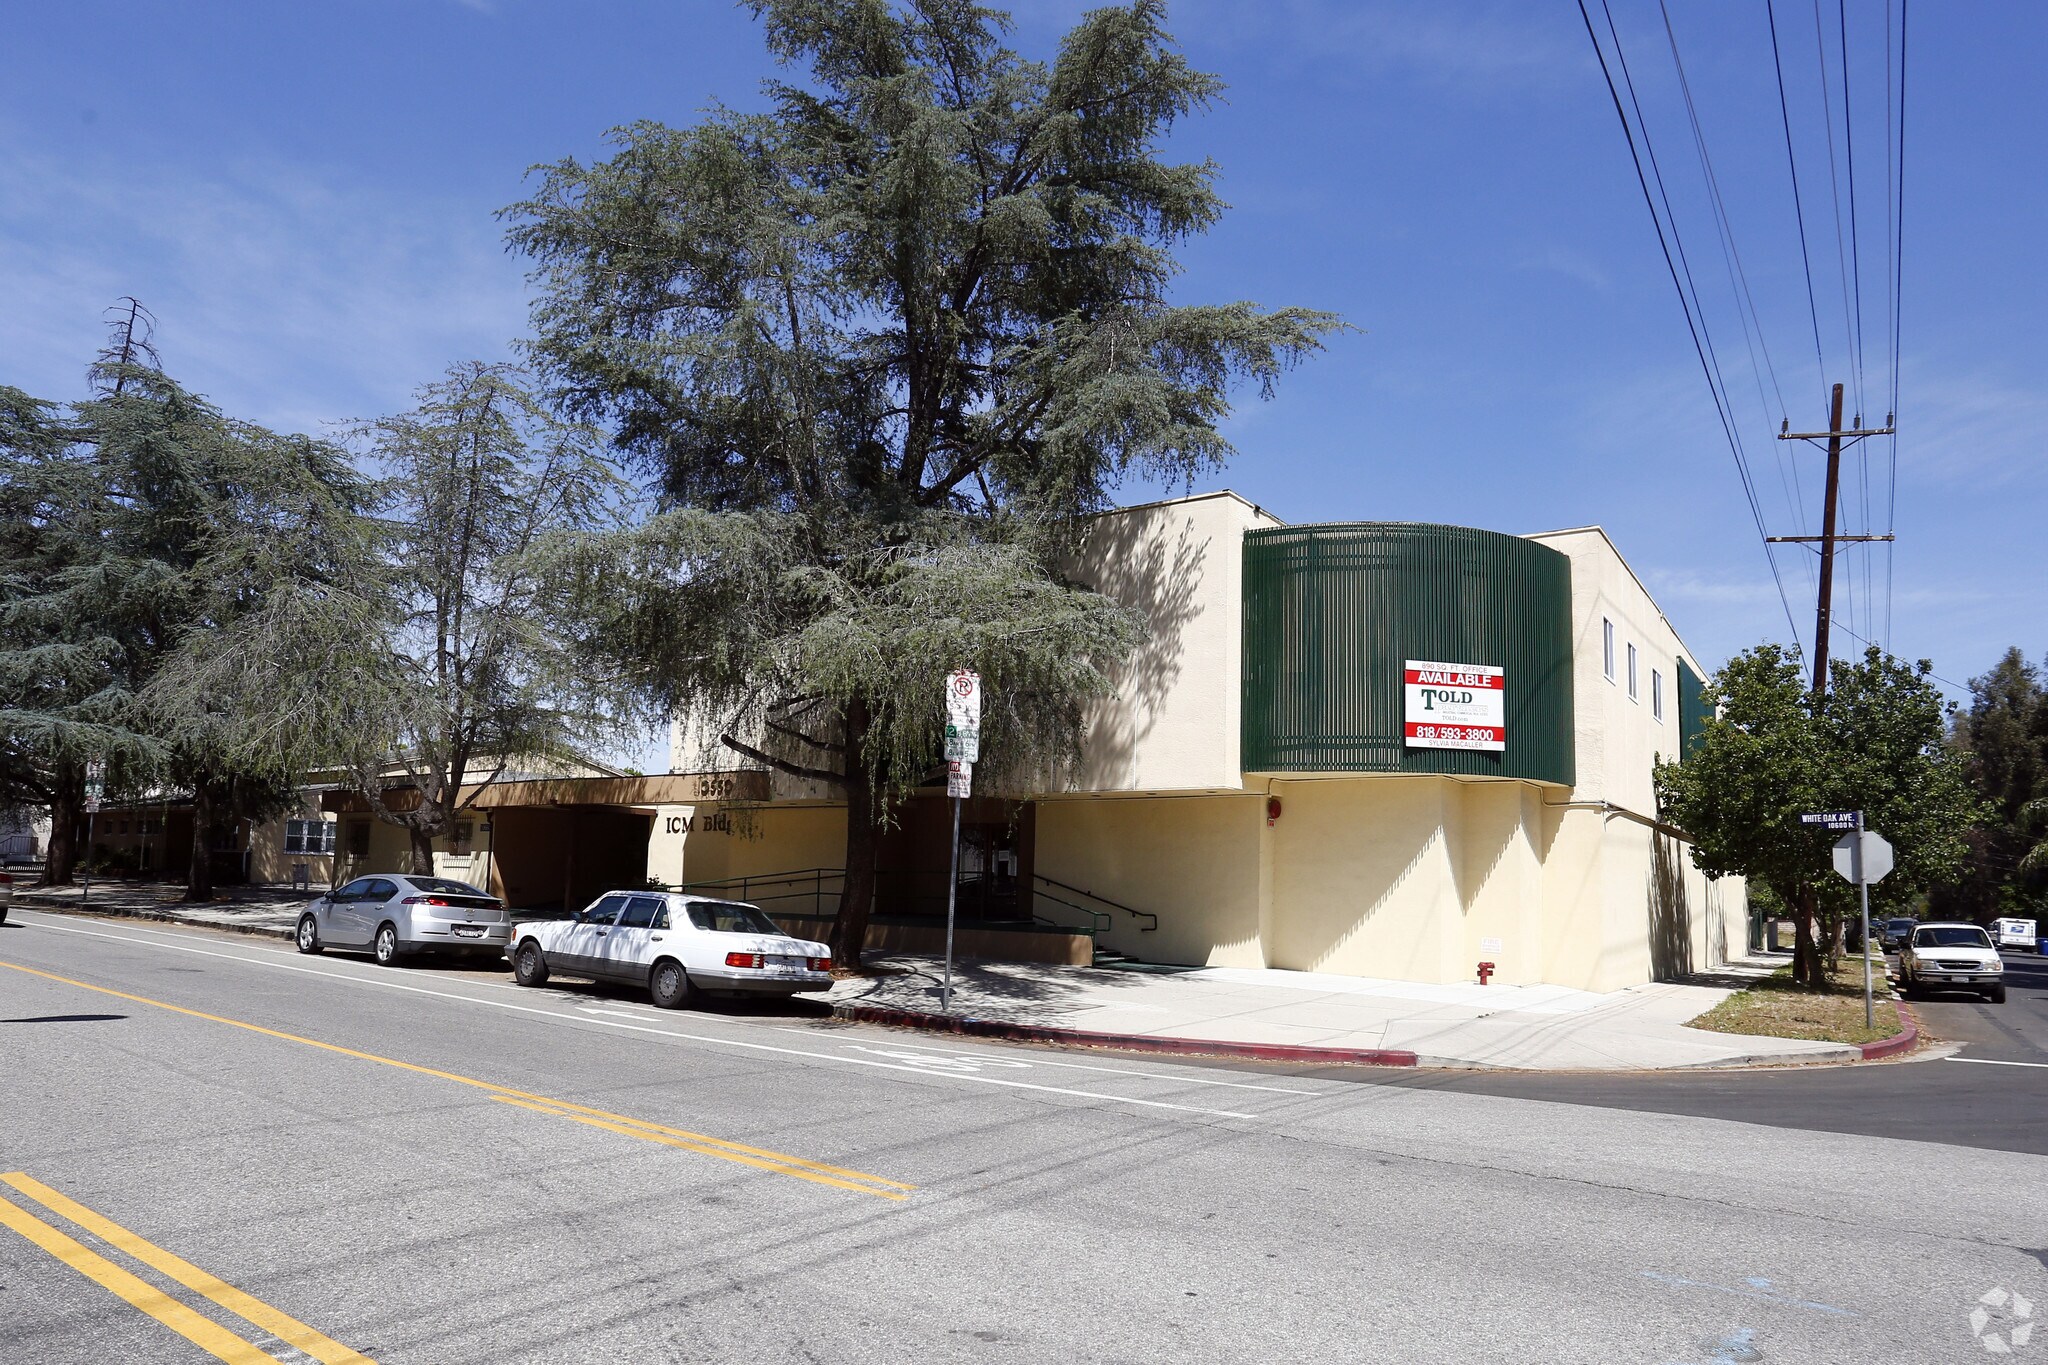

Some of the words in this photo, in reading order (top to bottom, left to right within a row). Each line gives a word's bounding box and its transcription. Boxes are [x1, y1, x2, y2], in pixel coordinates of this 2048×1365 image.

[1463, 665, 1488, 673] OFFICE
[1417, 671, 1492, 687] AVAILABLE
[1416, 726, 1493, 741] 818/593-3800
[666, 816, 694, 834] ICM
[1801, 814, 1821, 822] WHITE
[1822, 813, 1837, 822] OAK
